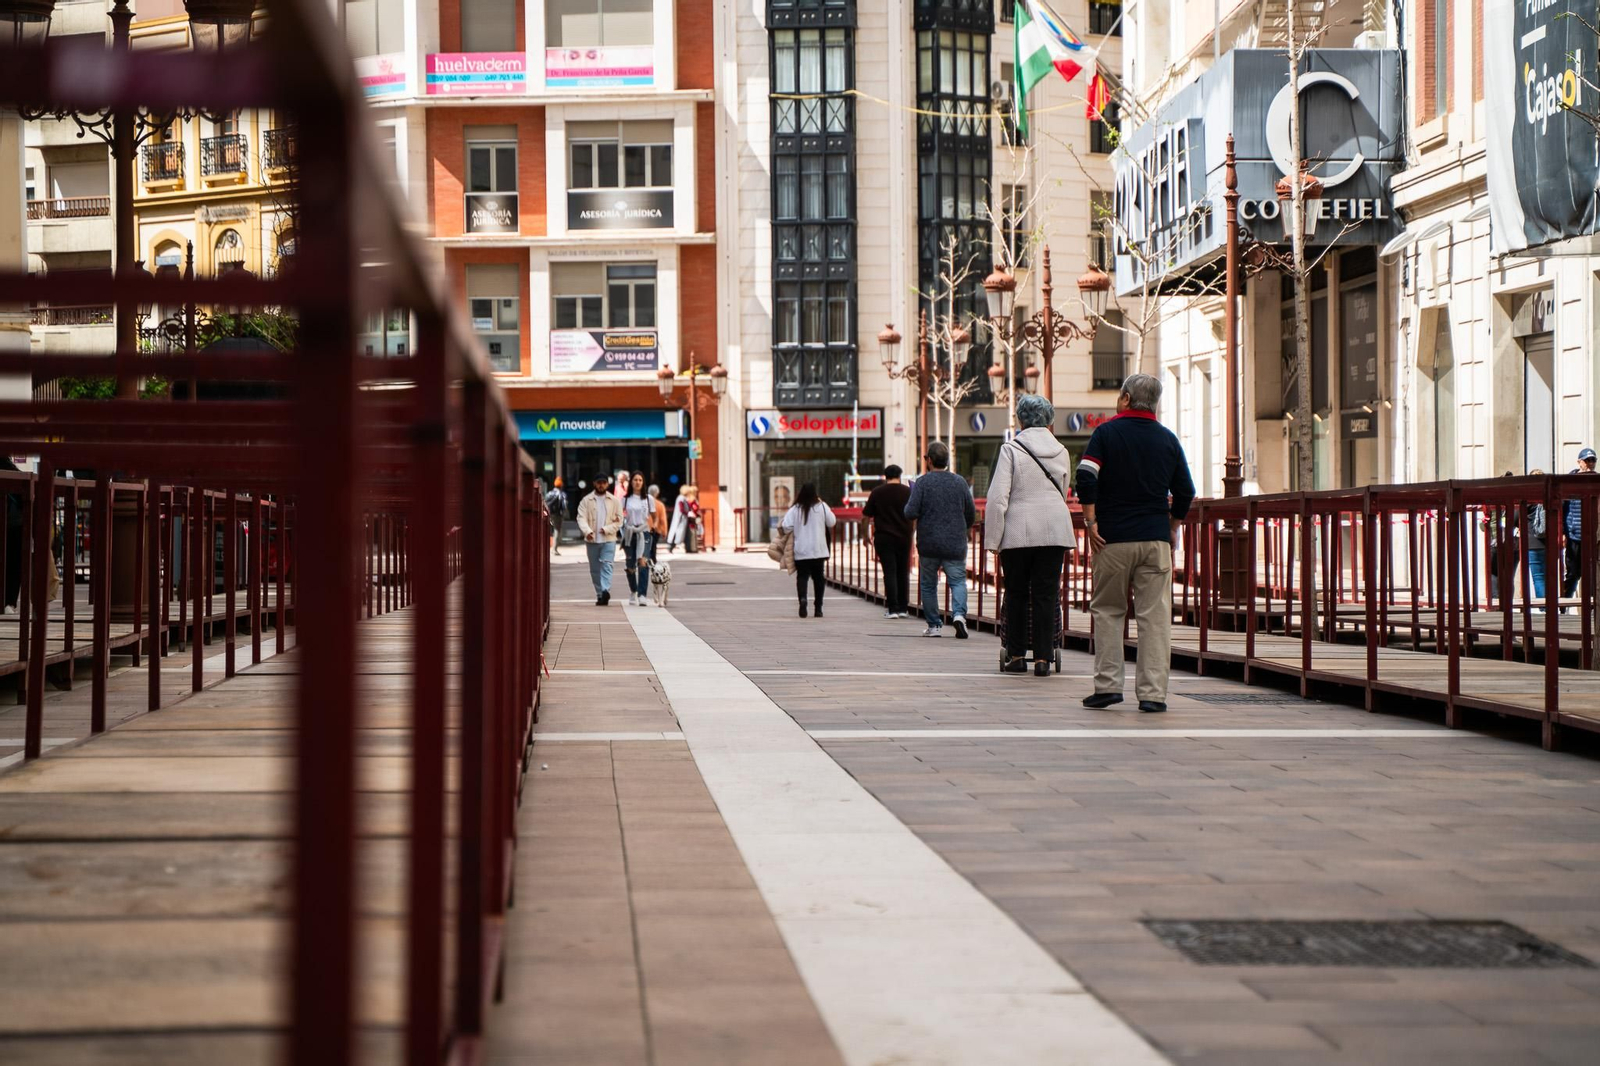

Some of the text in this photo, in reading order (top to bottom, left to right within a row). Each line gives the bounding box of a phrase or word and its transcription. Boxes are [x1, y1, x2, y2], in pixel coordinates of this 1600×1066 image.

[434, 57, 523, 73] huelvaderm
[580, 208, 662, 219] ASESORÍA JURÍDICA
[1239, 198, 1389, 220] COEFIEL
[614, 353, 627, 361] 959
[560, 420, 606, 430] movistar
[778, 414, 877, 434] Soloptical
